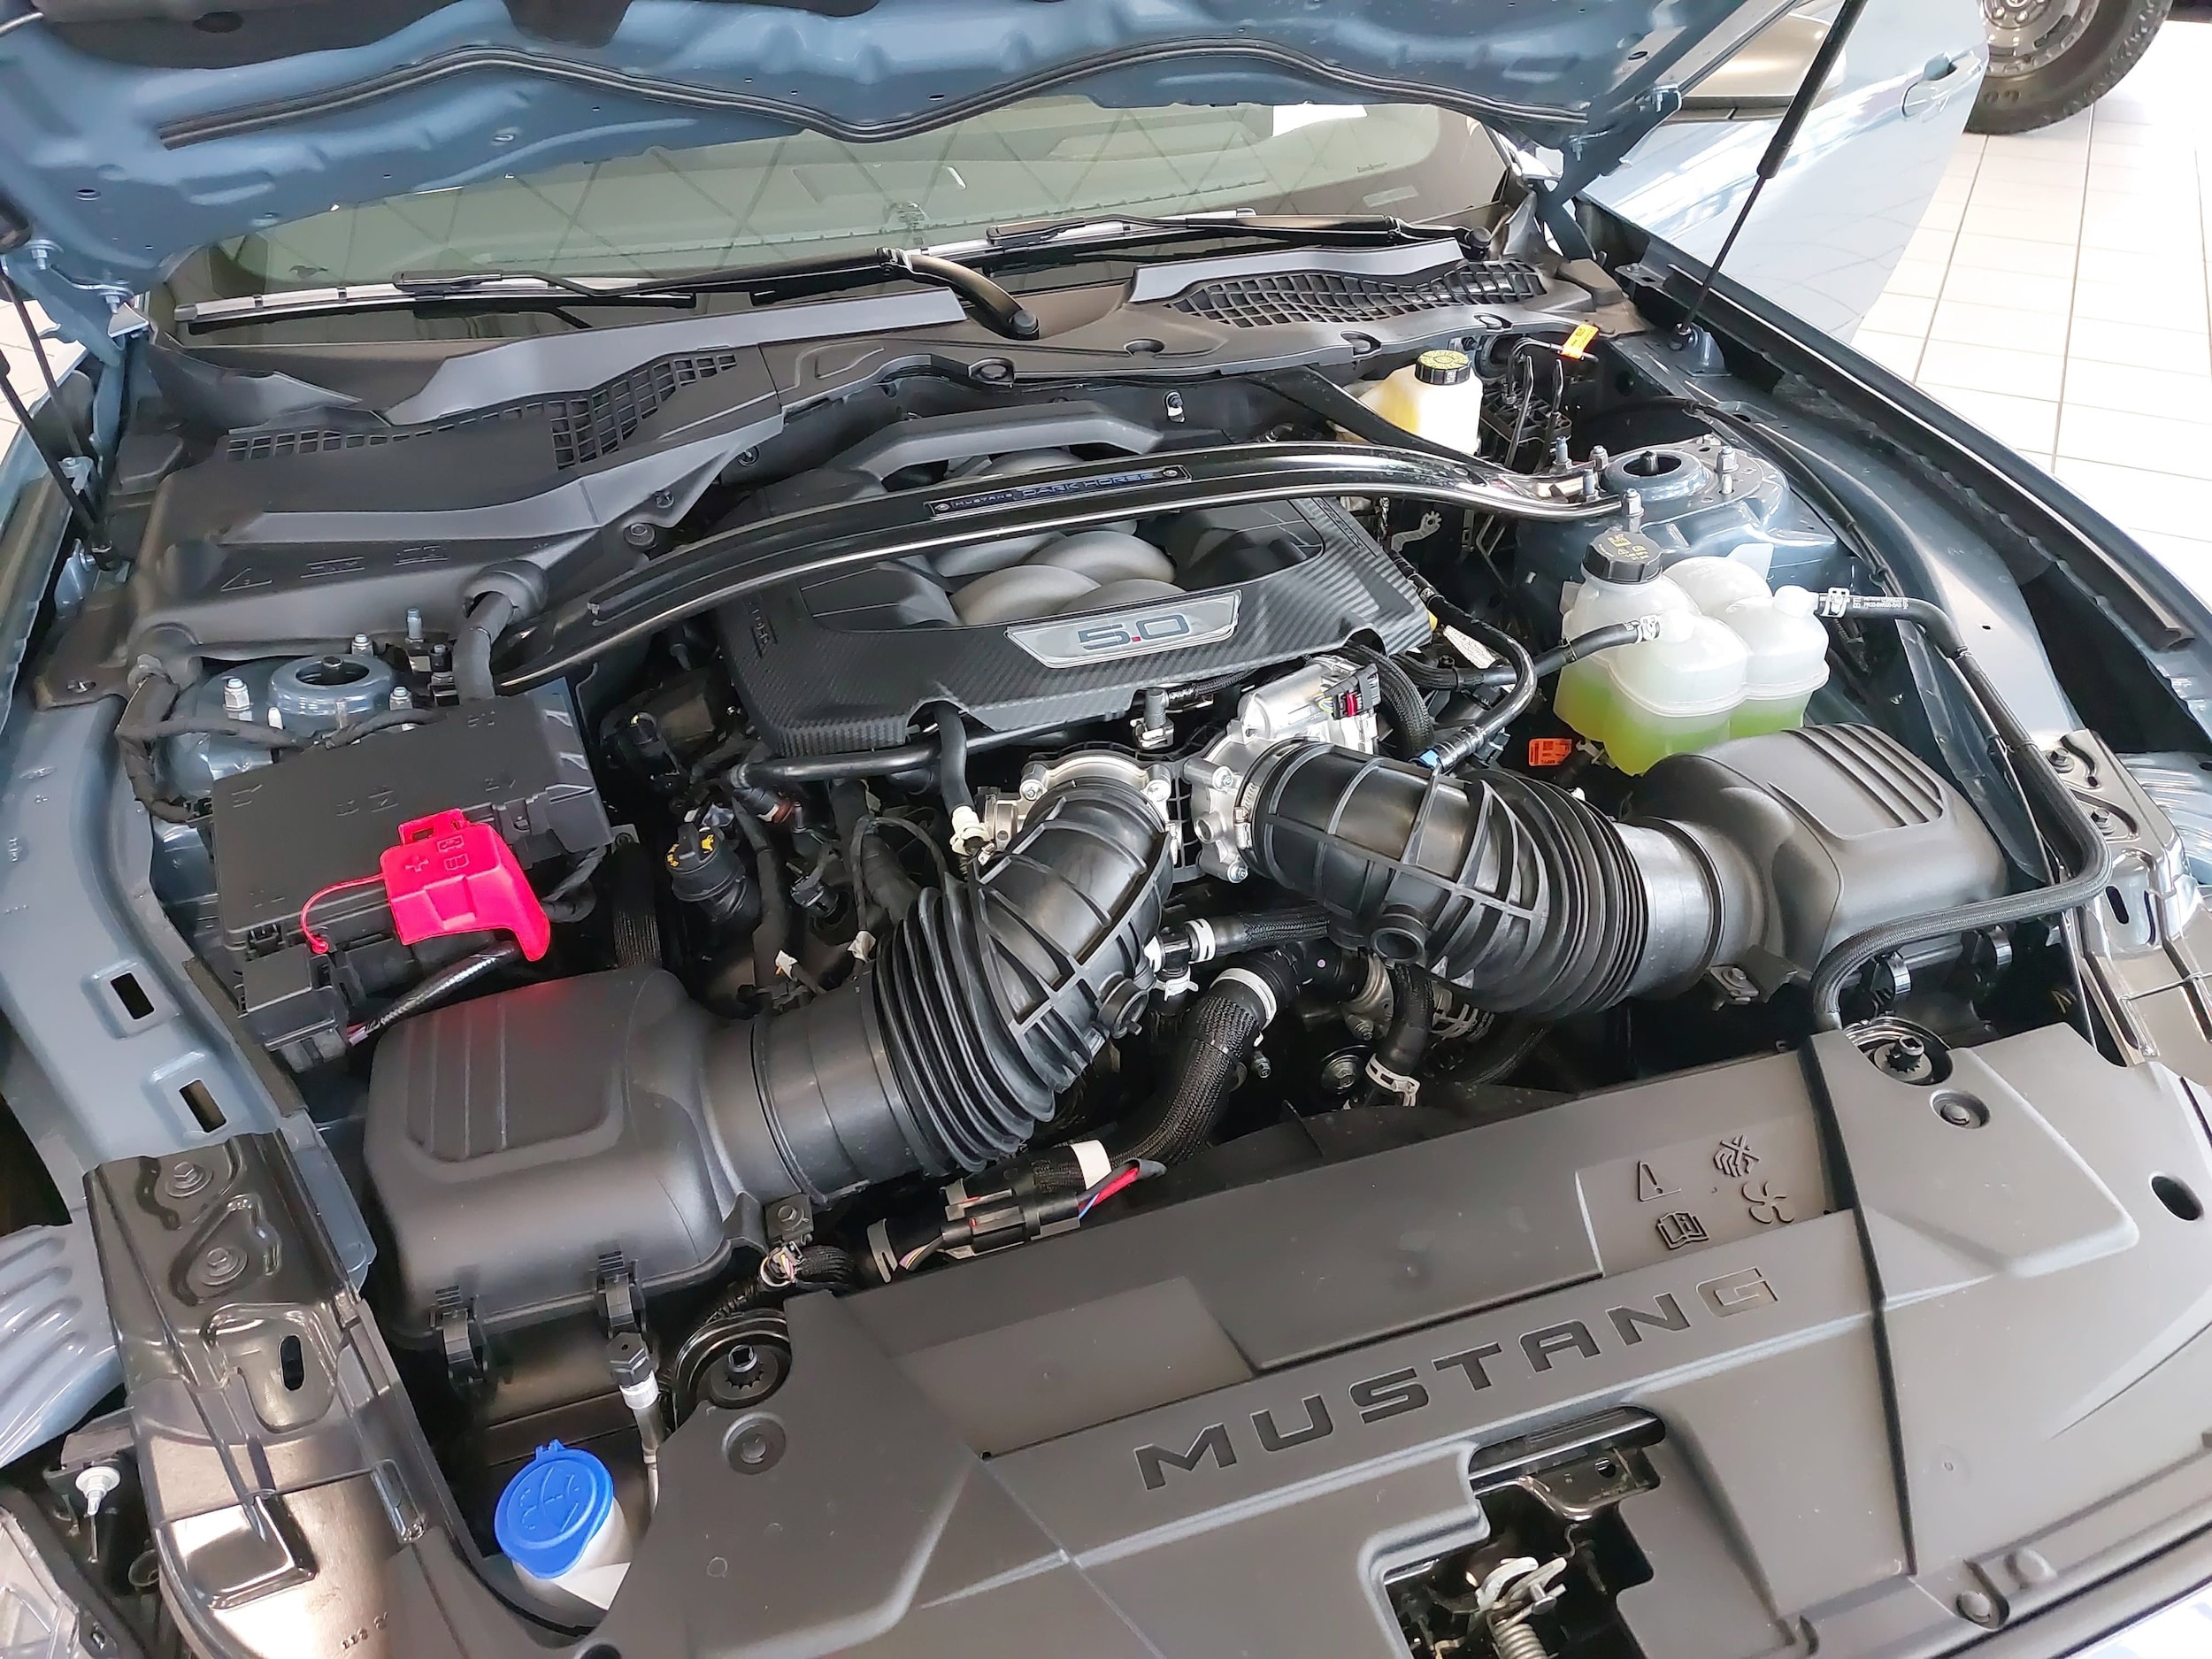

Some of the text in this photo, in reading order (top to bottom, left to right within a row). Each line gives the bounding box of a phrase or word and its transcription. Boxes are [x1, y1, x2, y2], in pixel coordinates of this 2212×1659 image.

[1022, 482, 1079, 496] DARK
[1083, 472, 1156, 488] HORSE
[1078, 613, 1191, 650] 5.0
[1133, 1266, 1779, 1490] MUSTANG
